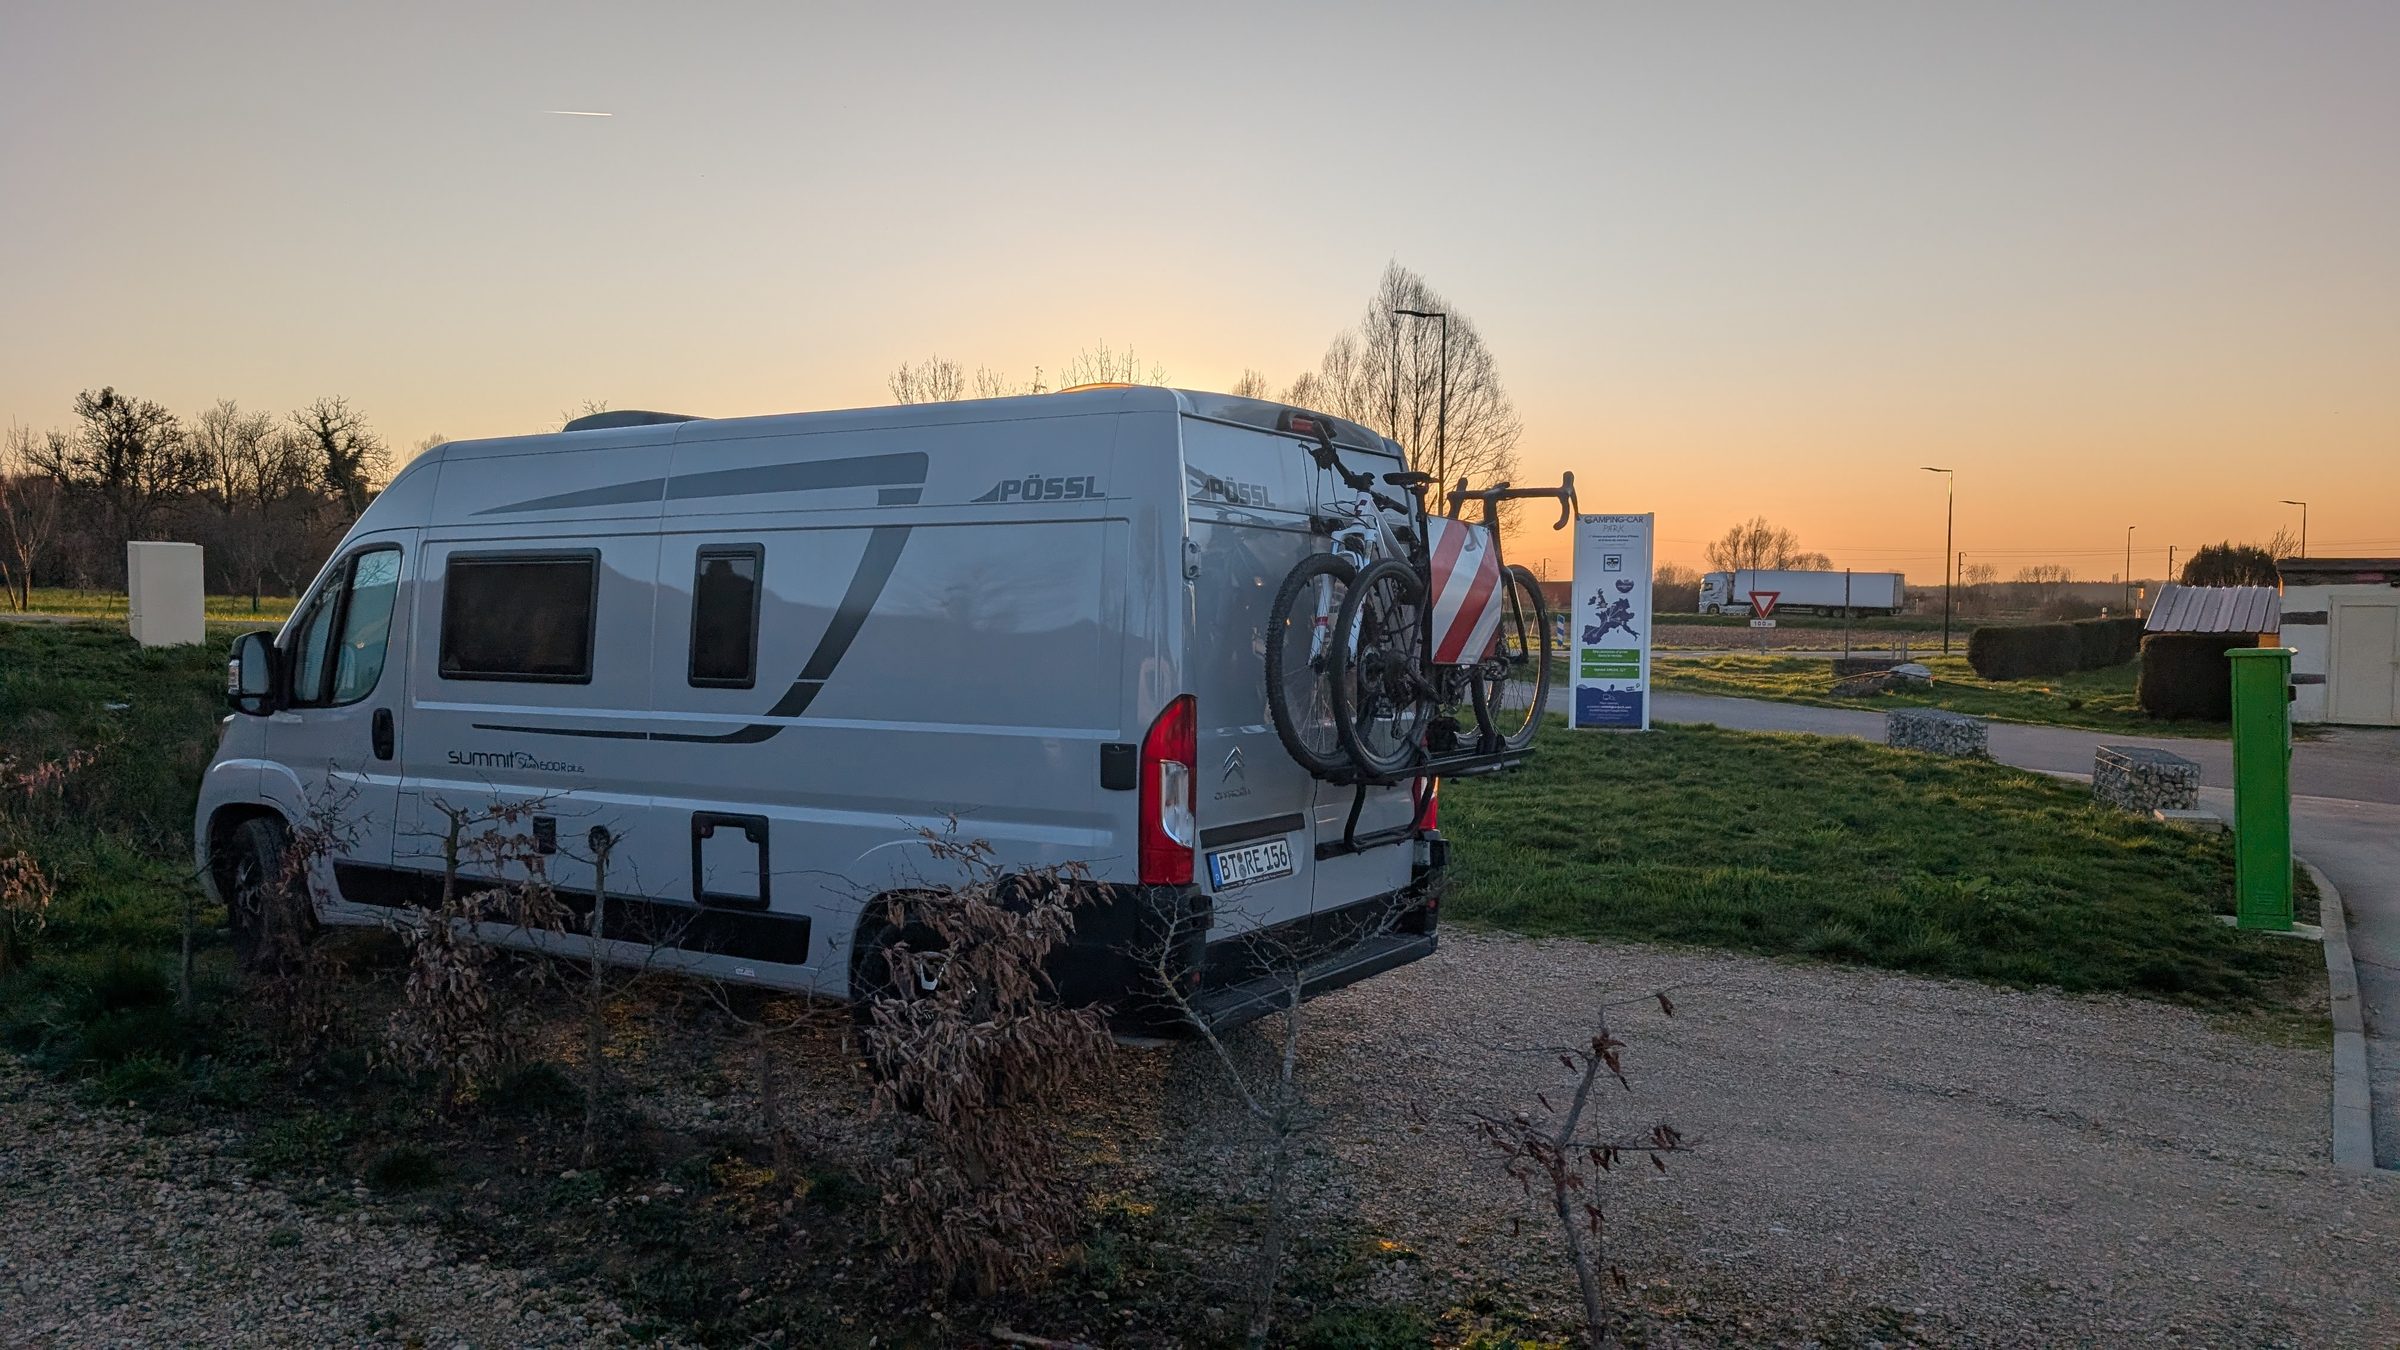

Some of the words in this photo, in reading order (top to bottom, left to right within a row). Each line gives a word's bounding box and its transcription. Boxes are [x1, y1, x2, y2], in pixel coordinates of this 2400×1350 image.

[1000, 474, 1105, 502] PÖSSL
[1210, 476, 1276, 508] PÖSSL
[1220, 854, 1238, 881] BT
